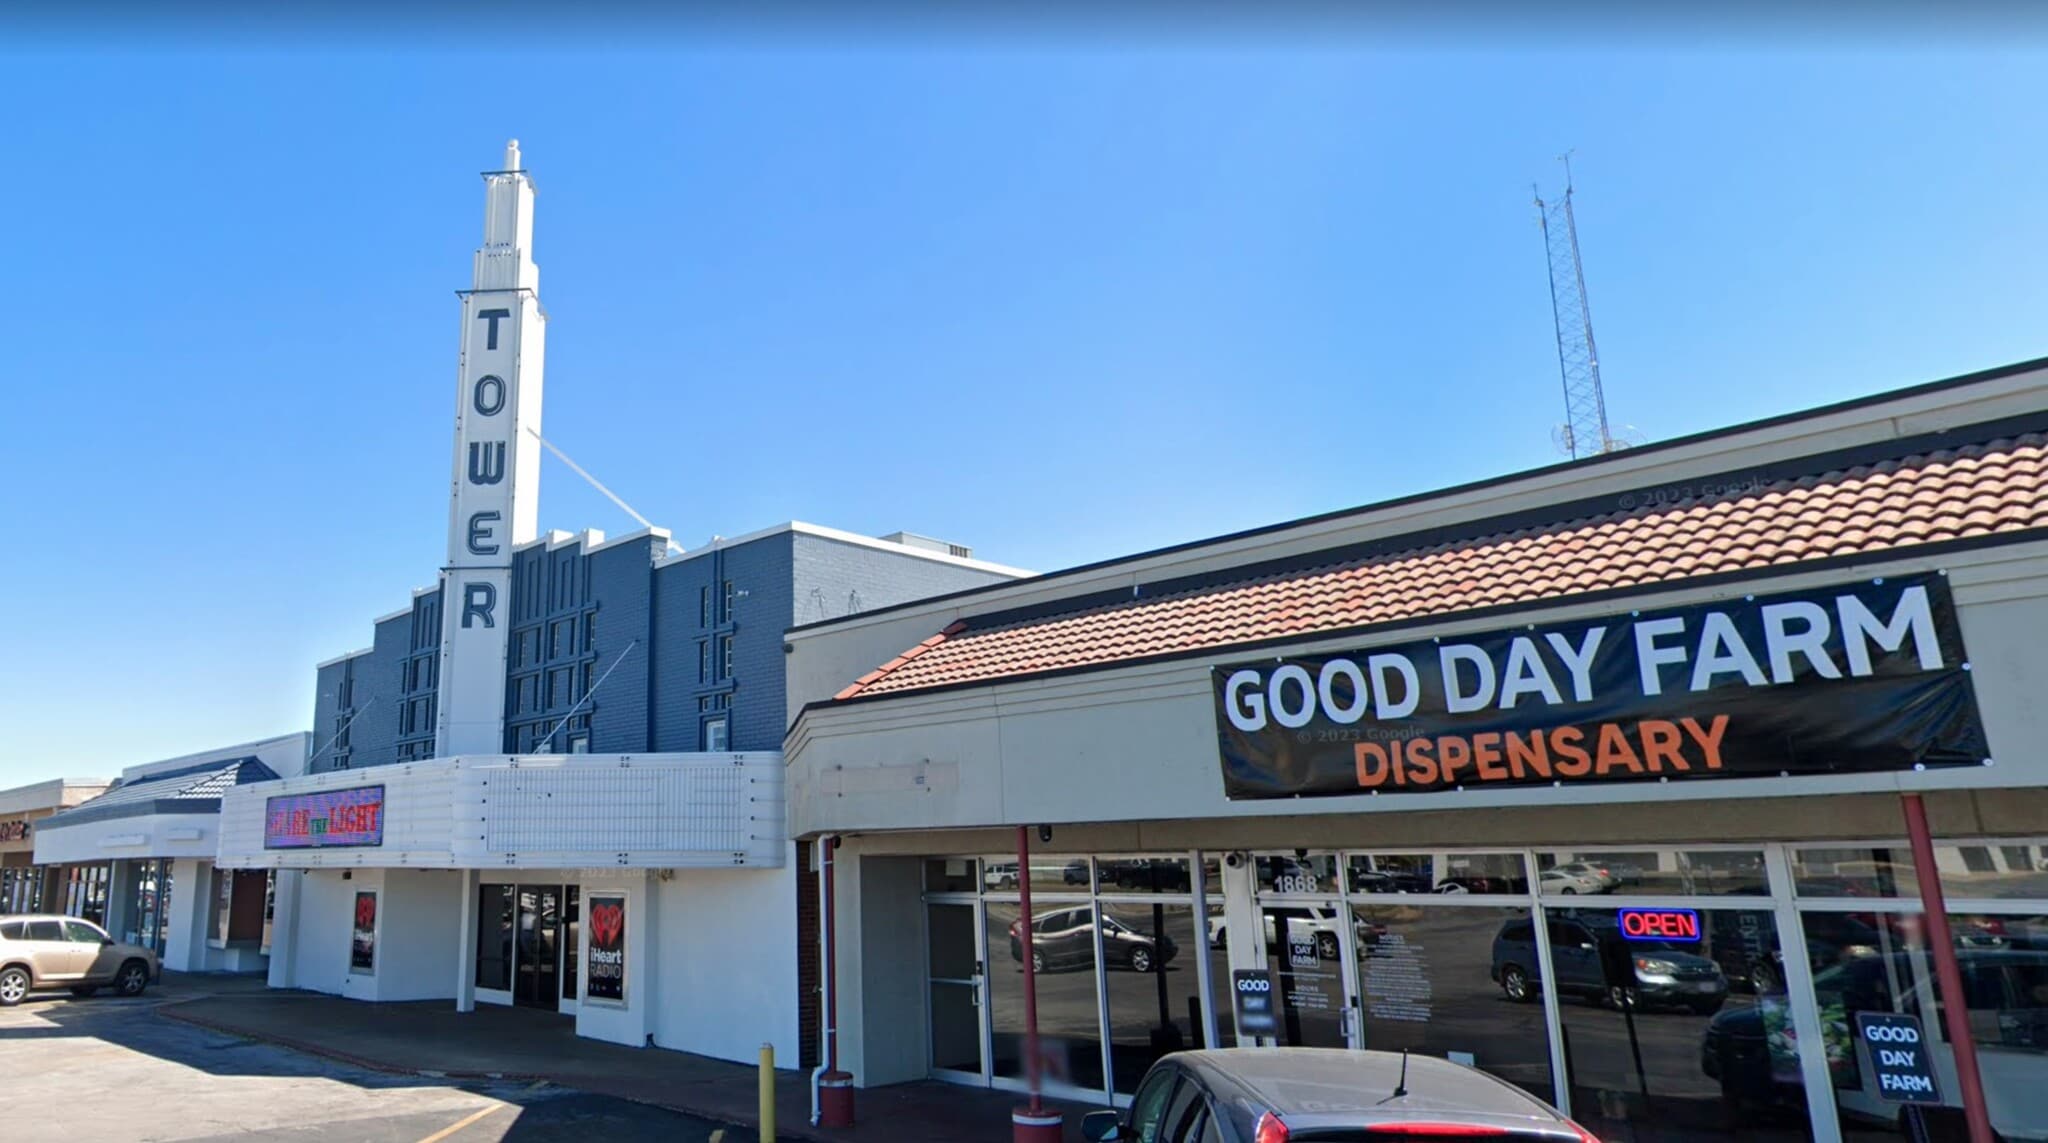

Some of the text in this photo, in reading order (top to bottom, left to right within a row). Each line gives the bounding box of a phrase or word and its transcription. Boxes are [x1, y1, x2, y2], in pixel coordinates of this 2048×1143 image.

[461, 308, 511, 629] TOWER
[1225, 585, 1945, 732] GOOD DAY FARM
[1354, 714, 1730, 787] DISPENSARY
[328, 801, 382, 834] LIGHT
[1274, 875, 1318, 892] 1868
[1624, 912, 1697, 937] OPEN
[590, 947, 621, 964] iHeart
[1295, 945, 1312, 954] DAY
[1292, 955, 1316, 965] FARM
[590, 963, 622, 979] RADIO
[1237, 979, 1269, 991] GOOD
[1866, 1025, 1919, 1043] GOOD
[1880, 1049, 1915, 1067] DAY
[1880, 1073, 1933, 1092] FARM
